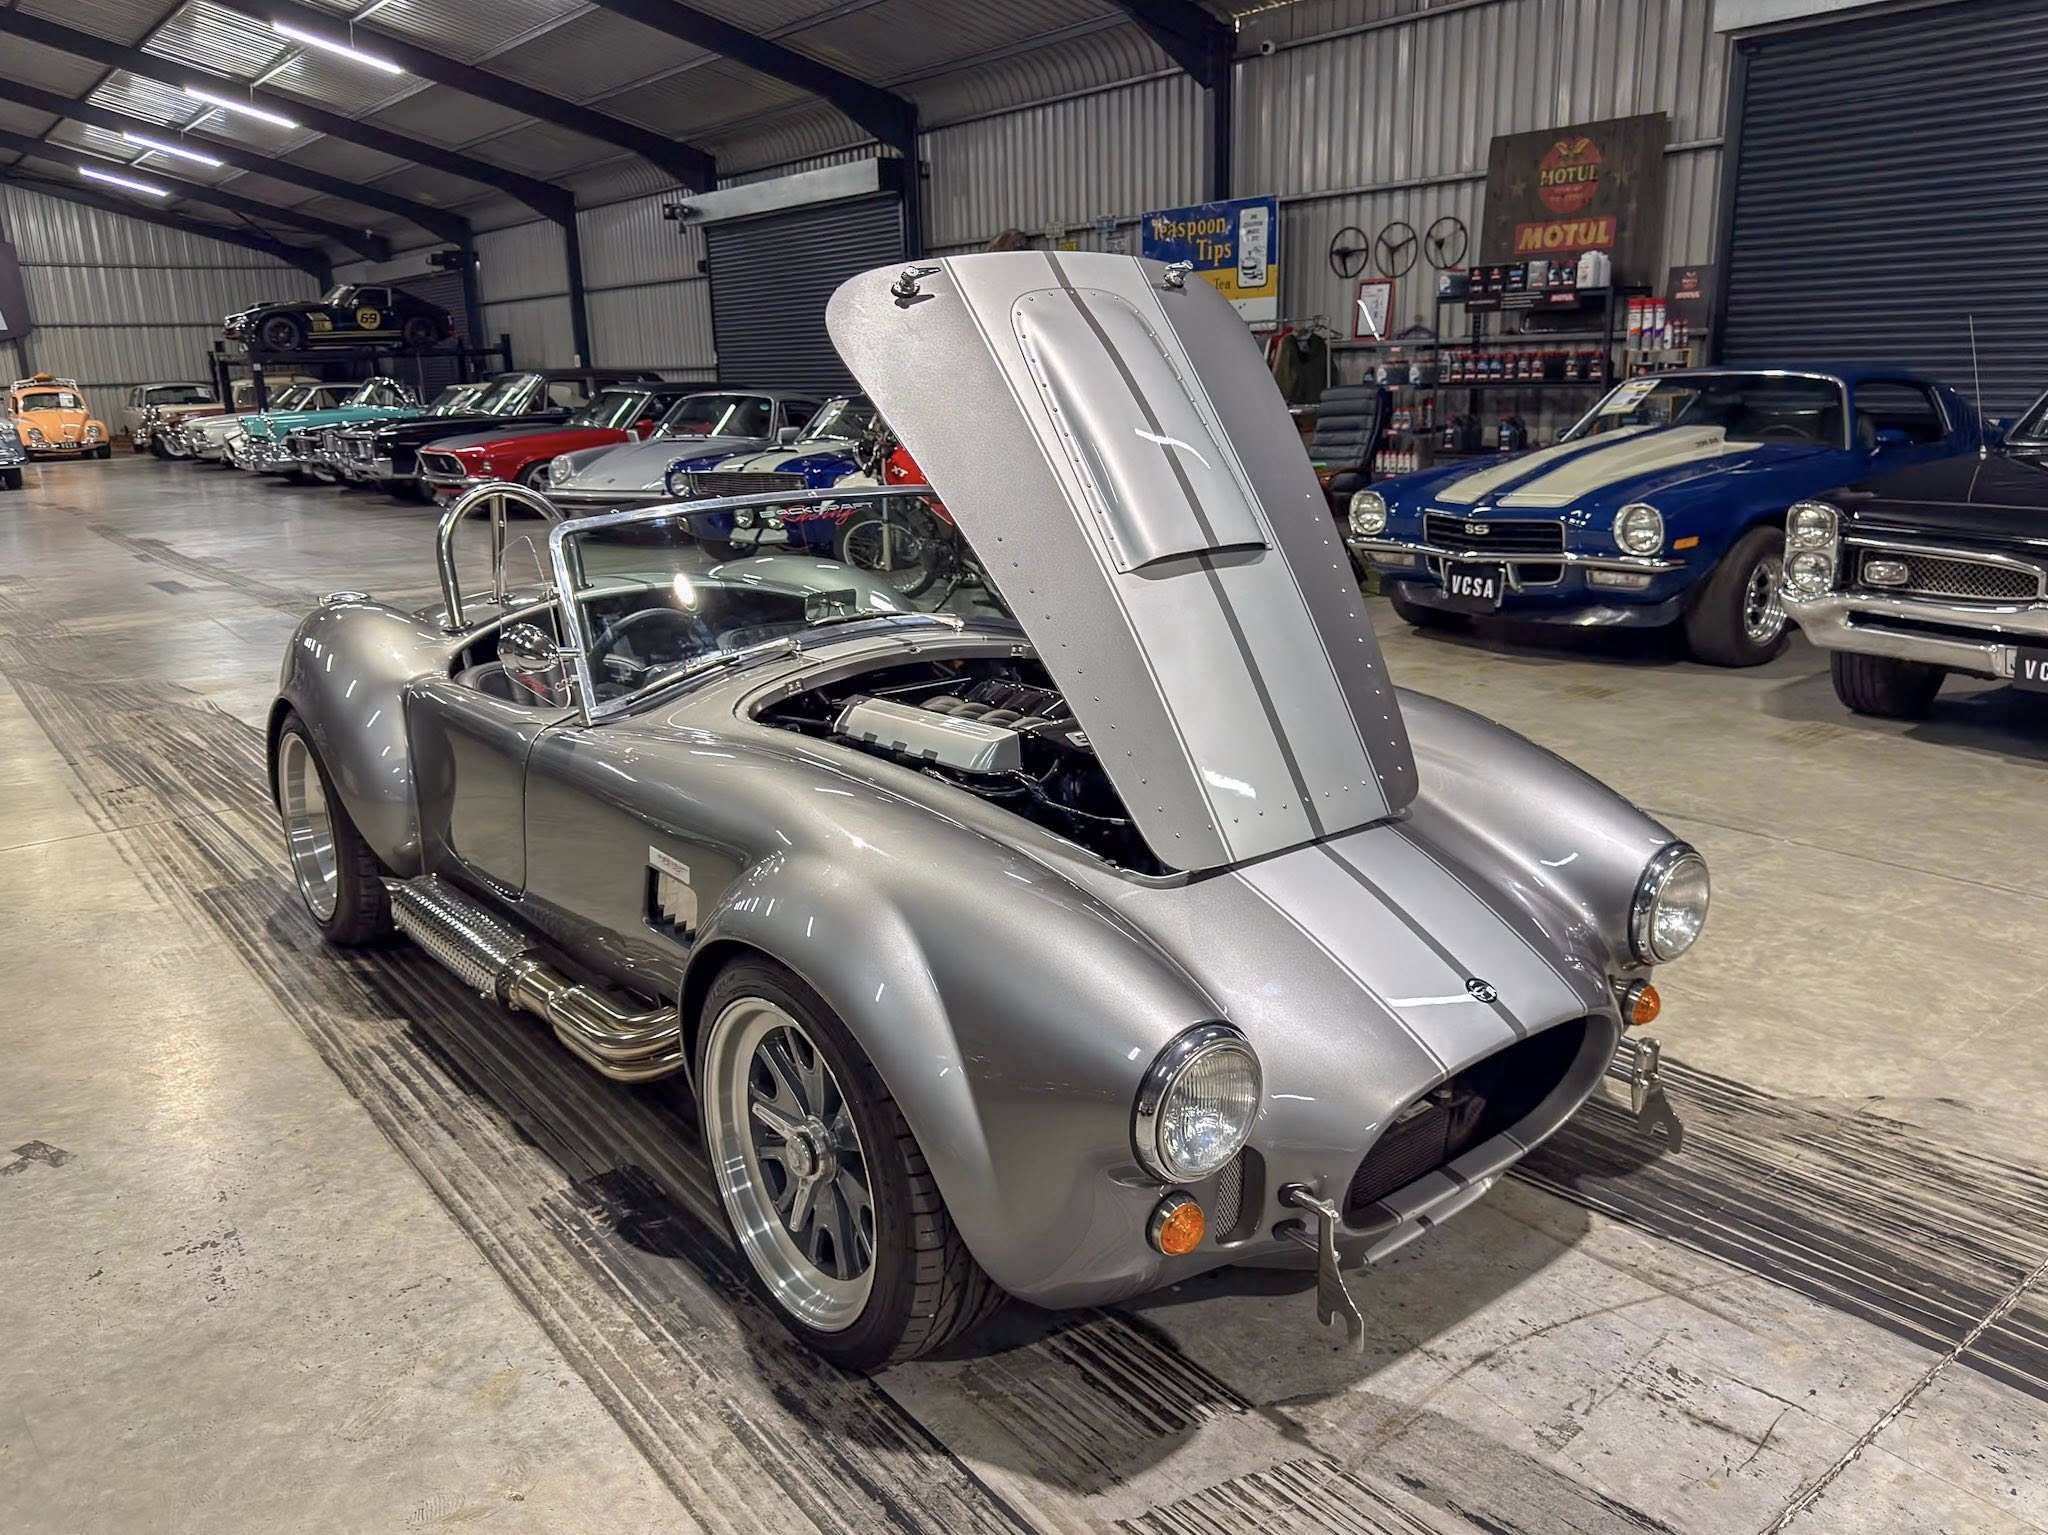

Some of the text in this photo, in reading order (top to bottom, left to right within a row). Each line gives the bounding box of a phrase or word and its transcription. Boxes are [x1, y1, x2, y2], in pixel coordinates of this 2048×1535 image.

[1540, 164, 1598, 187] MOTUL
[1152, 217, 1226, 244] Teaspoon
[1518, 220, 1609, 250] MOTUL
[1196, 238, 1232, 267] Tips
[360, 313, 377, 324] 69
[759, 500, 873, 519] BACKDRAFT
[1464, 523, 1490, 535] SS
[1452, 574, 1494, 599] VCSA
[2025, 659, 2048, 682] VC
